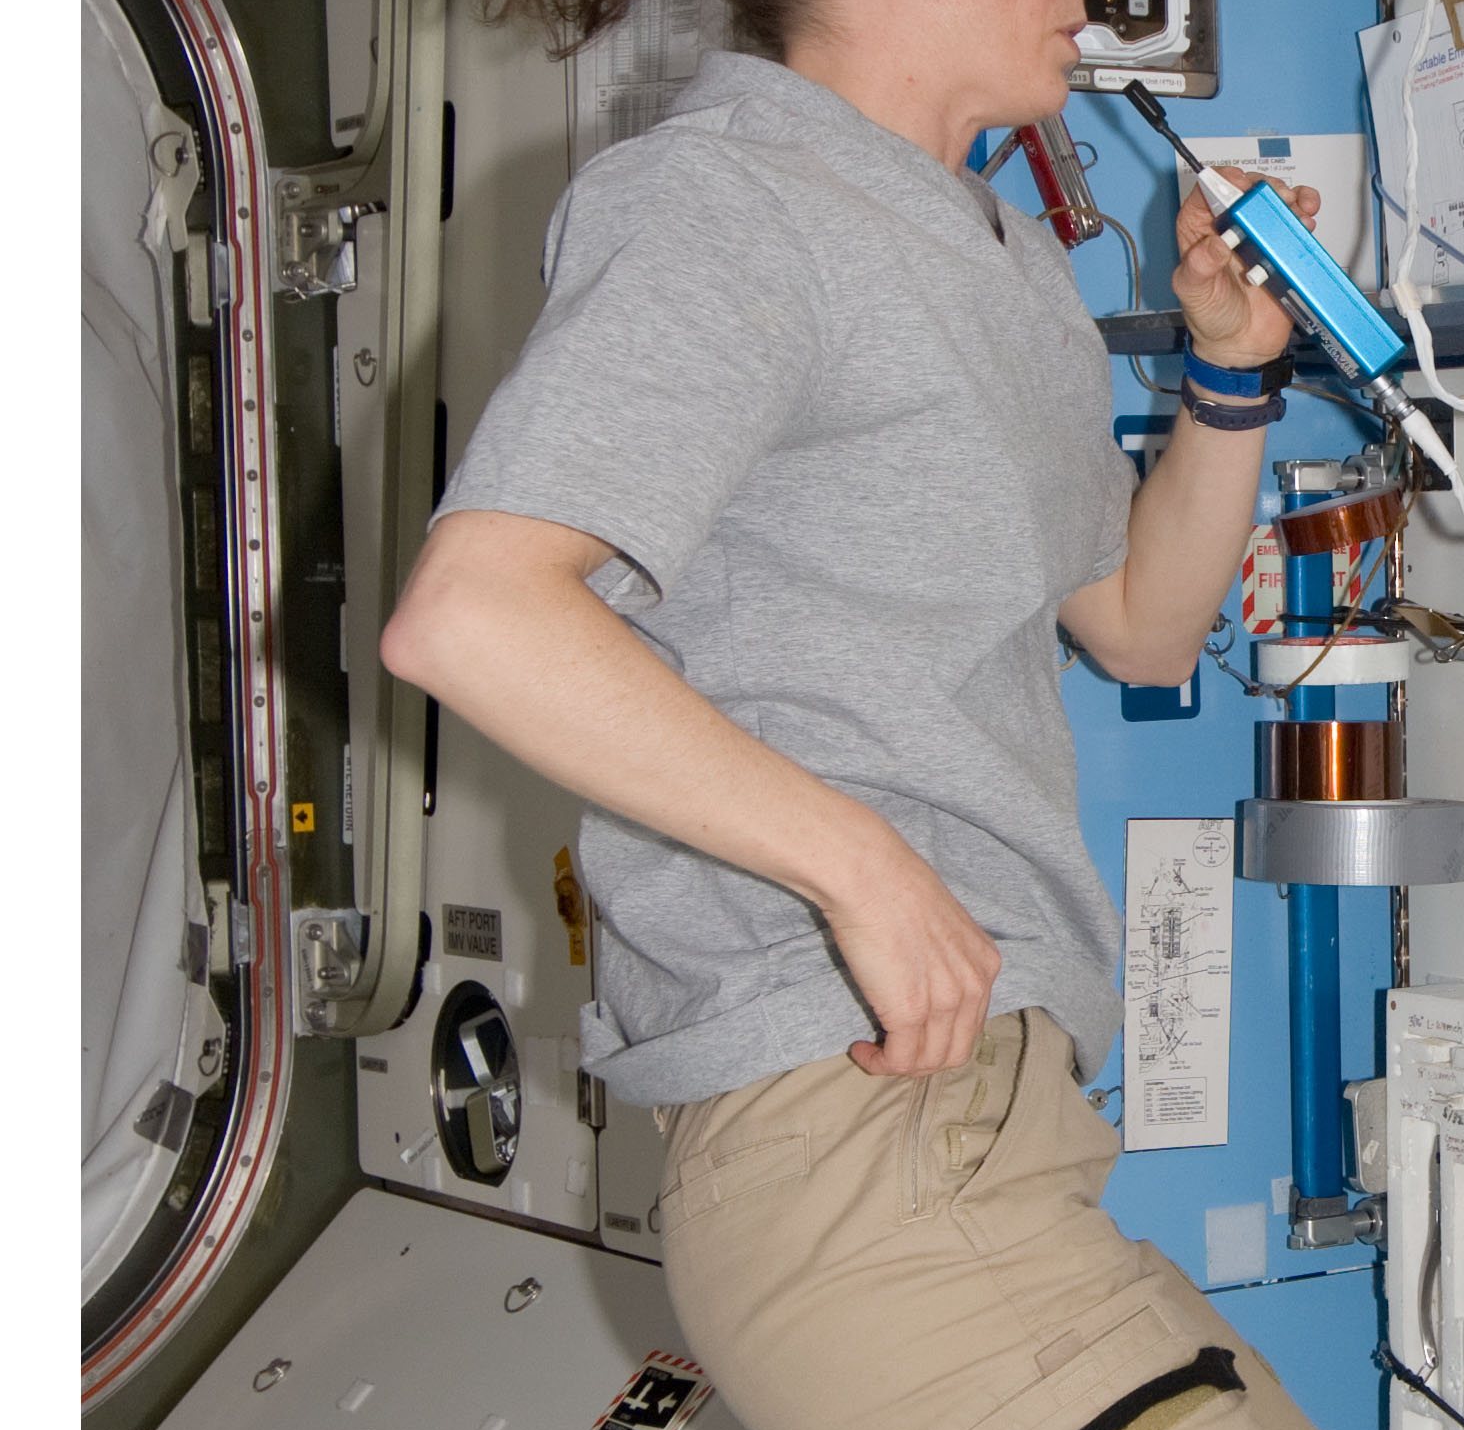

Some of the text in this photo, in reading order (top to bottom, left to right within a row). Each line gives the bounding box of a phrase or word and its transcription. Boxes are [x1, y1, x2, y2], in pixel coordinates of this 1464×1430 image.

[1098, 74, 1117, 83] Audio
[1241, 158, 1256, 166] VOICE
[344, 784, 353, 832] RETURN
[447, 908, 496, 932] AFT PORT
[447, 931, 497, 955] IMV VALVE
